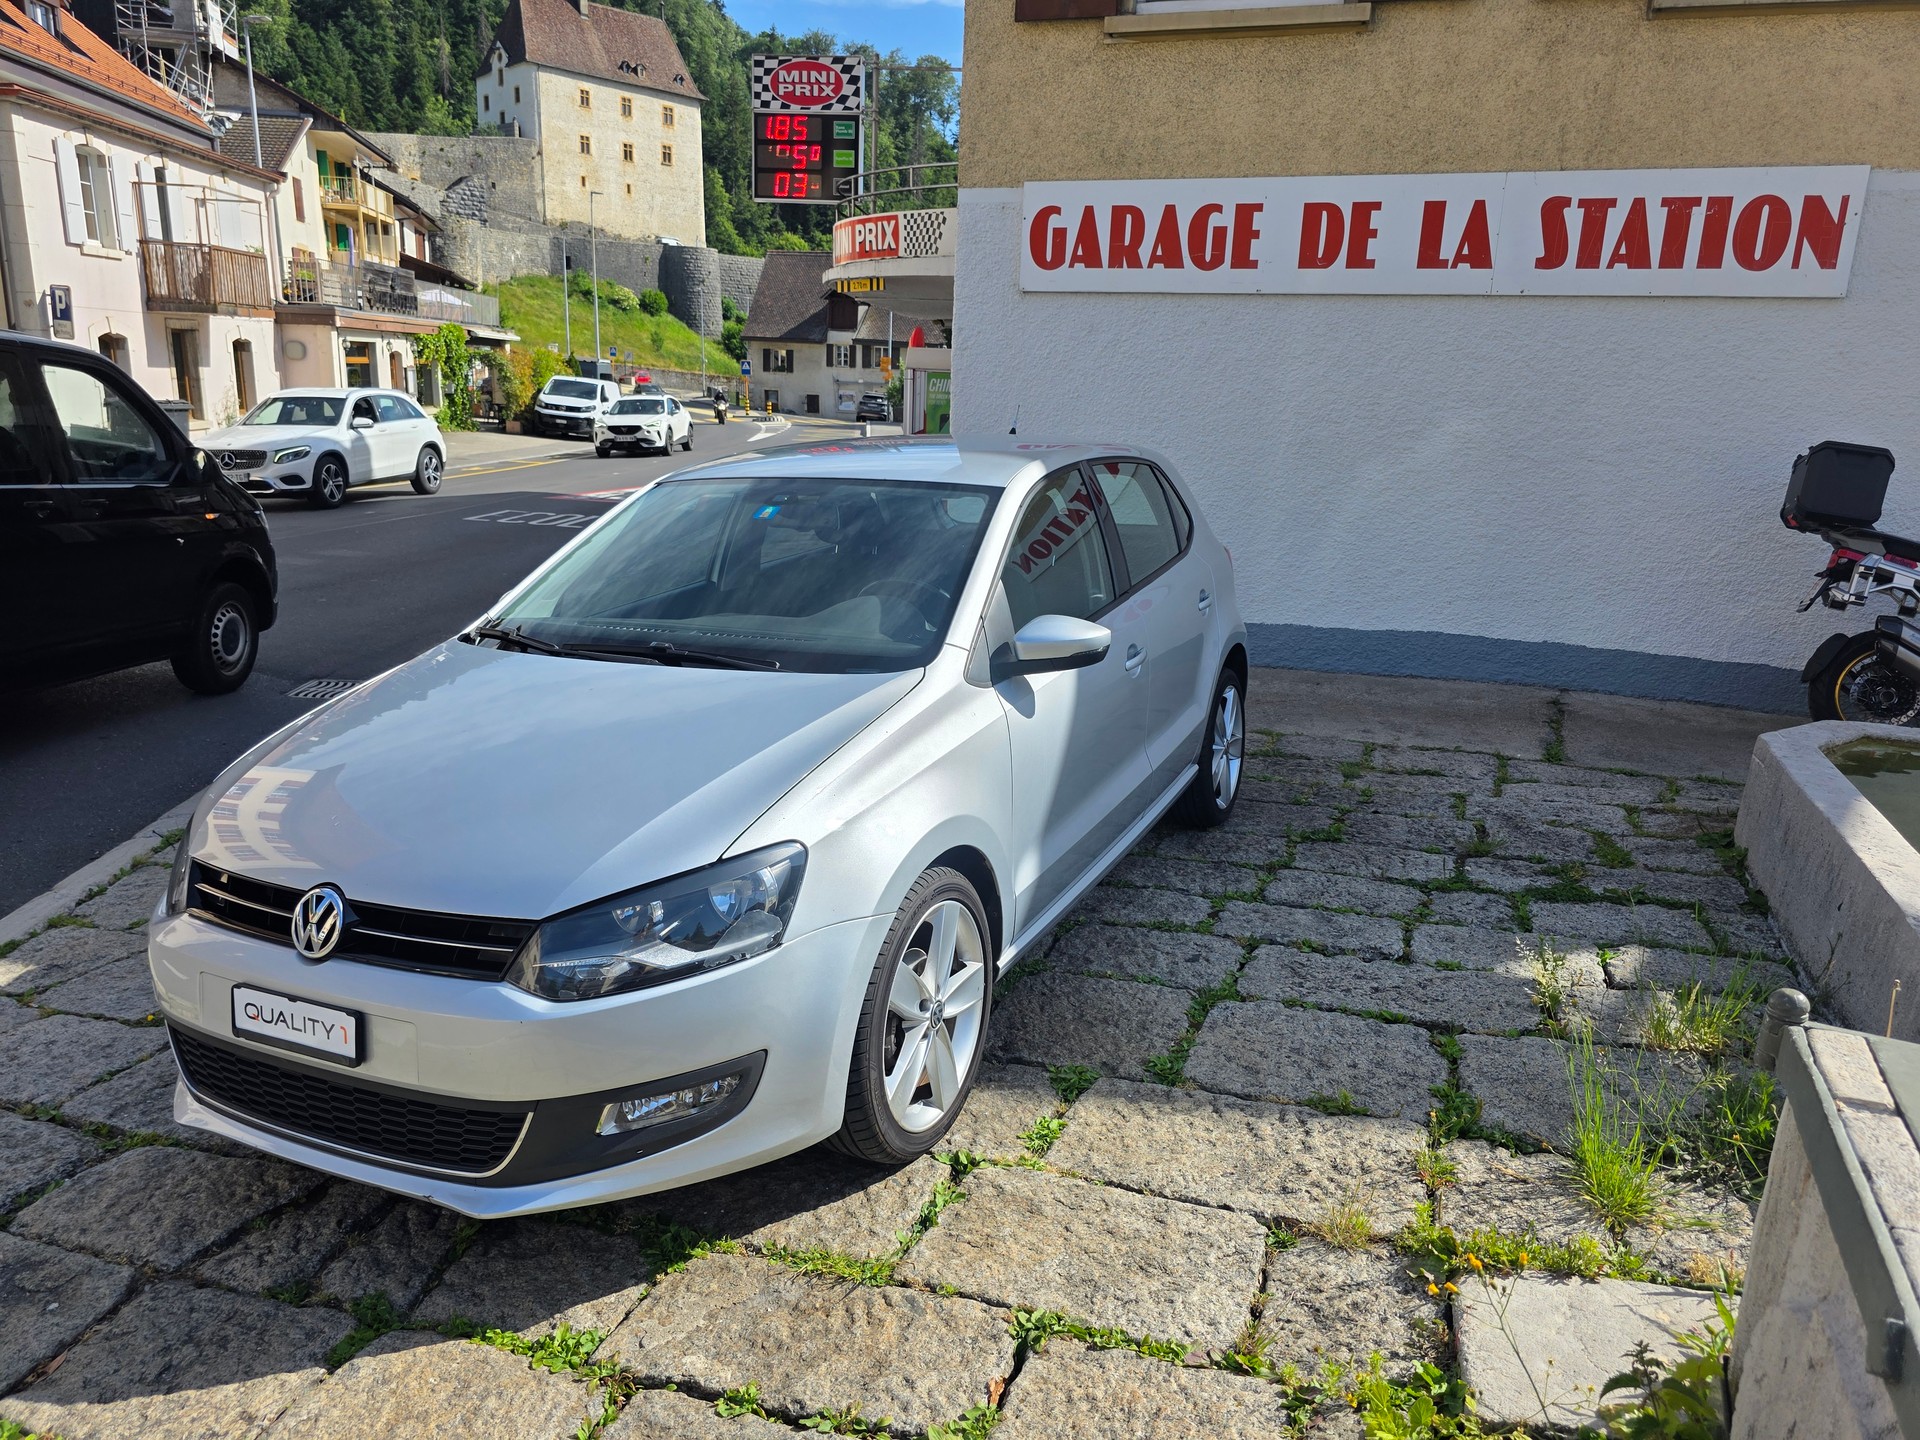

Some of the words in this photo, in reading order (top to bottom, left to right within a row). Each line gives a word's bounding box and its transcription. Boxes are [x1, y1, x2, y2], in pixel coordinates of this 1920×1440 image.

[777, 70, 836, 84] MINI
[777, 84, 836, 97] PRIX
[855, 219, 897, 253] PRIX
[1029, 202, 1264, 271] GARAGE
[1298, 201, 1382, 269] DE
[1416, 199, 1493, 269] LA
[1534, 194, 1851, 271] STATION
[54, 289, 67, 318] P
[462, 509, 603, 529] ECOL
